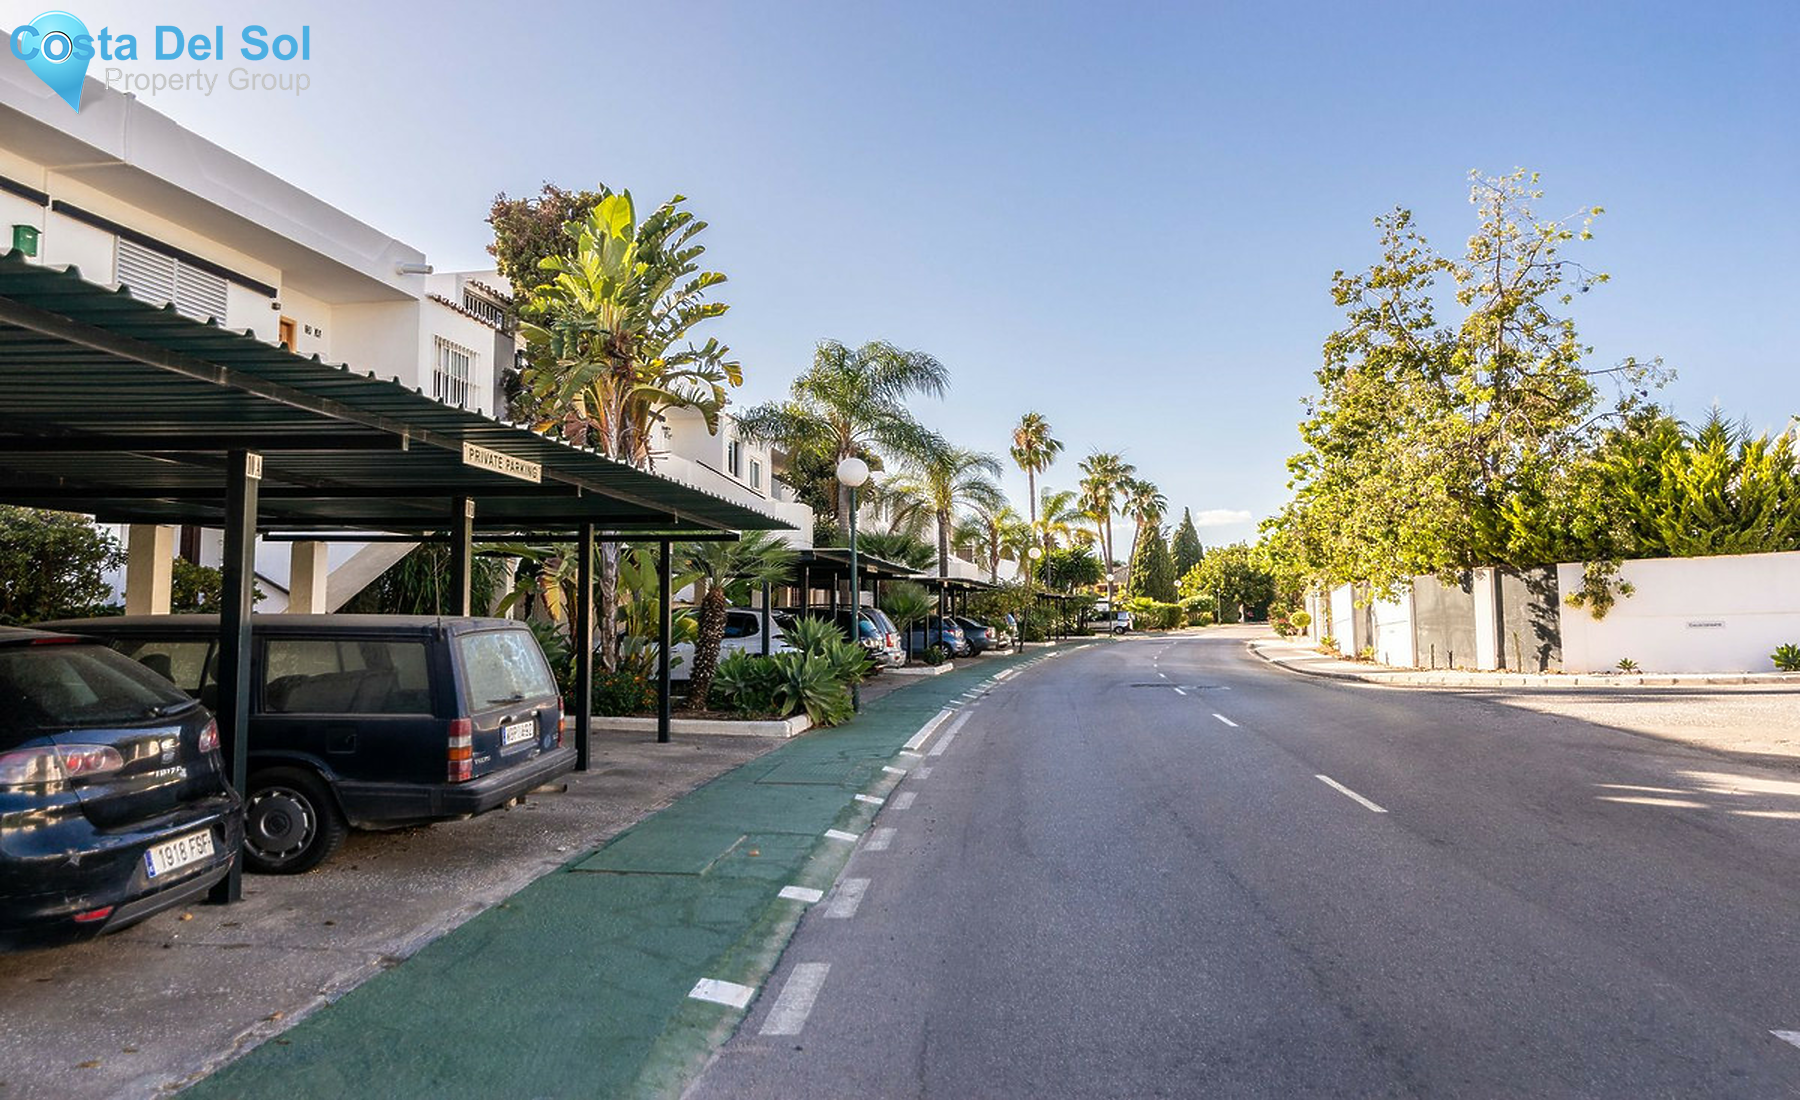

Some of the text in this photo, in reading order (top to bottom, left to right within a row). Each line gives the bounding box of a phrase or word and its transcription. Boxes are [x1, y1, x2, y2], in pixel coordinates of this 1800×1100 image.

[469, 448, 538, 478] PRIVATE PARKING
[159, 842, 188, 868] 1918
